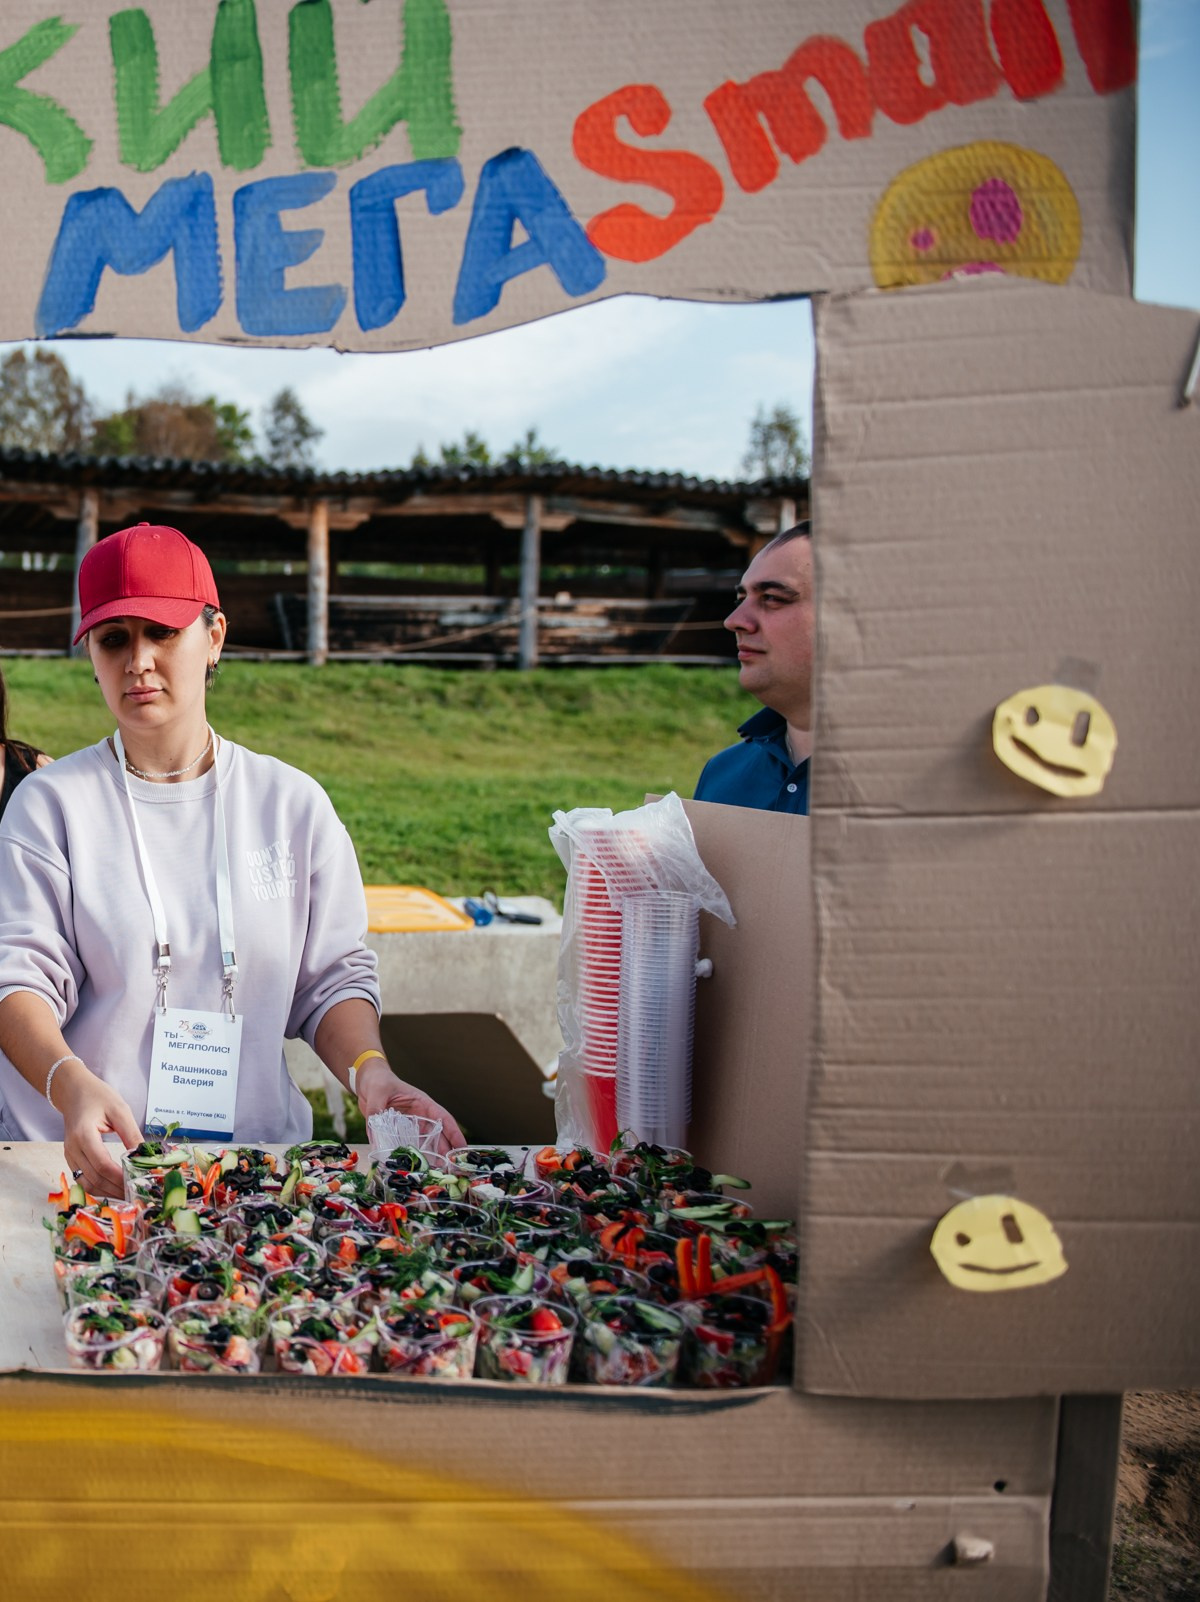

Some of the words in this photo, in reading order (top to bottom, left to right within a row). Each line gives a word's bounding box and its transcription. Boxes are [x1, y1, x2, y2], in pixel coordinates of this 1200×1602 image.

[34, 147, 607, 338] МЕГА
[164, 1031, 179, 1039] ТЫ
[168, 1041, 231, 1054] МЕГАПОЛИС!
[161, 1062, 227, 1076] Калашникова
[172, 1075, 215, 1088] Валерия
